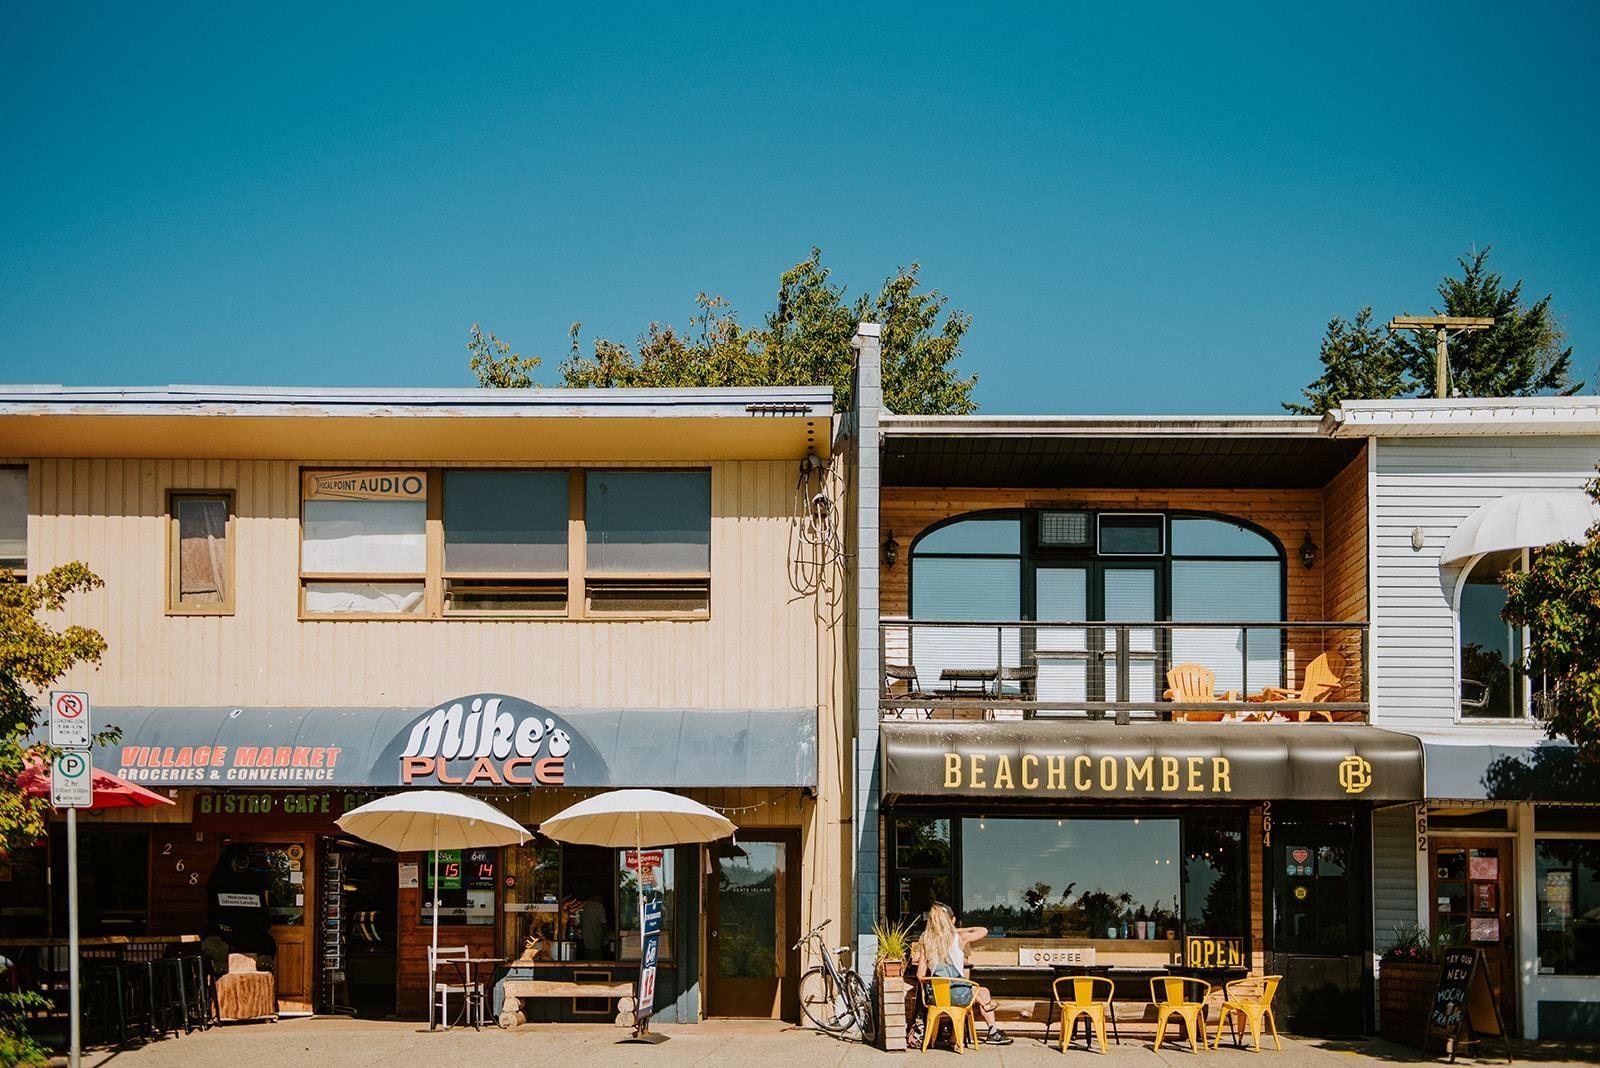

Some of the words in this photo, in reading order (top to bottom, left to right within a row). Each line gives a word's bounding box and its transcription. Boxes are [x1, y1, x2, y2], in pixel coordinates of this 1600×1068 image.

[333, 480, 356, 491] POINT
[359, 476, 423, 495] AUDIO
[121, 746, 227, 768] VILLAGE
[233, 747, 342, 768] MARKET
[117, 767, 205, 782] GROCERIES
[209, 769, 220, 781] &
[226, 768, 334, 781] CONVENIENCE
[402, 757, 565, 785] PLACE
[943, 752, 1233, 793] BEACHCOMBER
[200, 793, 272, 814] BISTRO
[283, 793, 330, 814] CAFE
[445, 863, 459, 877] 15
[478, 863, 494, 877] 14
[1033, 952, 1082, 963] COFFEE
[1190, 939, 1240, 965] OPEN
[1447, 969, 1468, 980] NEW
[1437, 987, 1466, 1003] MOCHA
